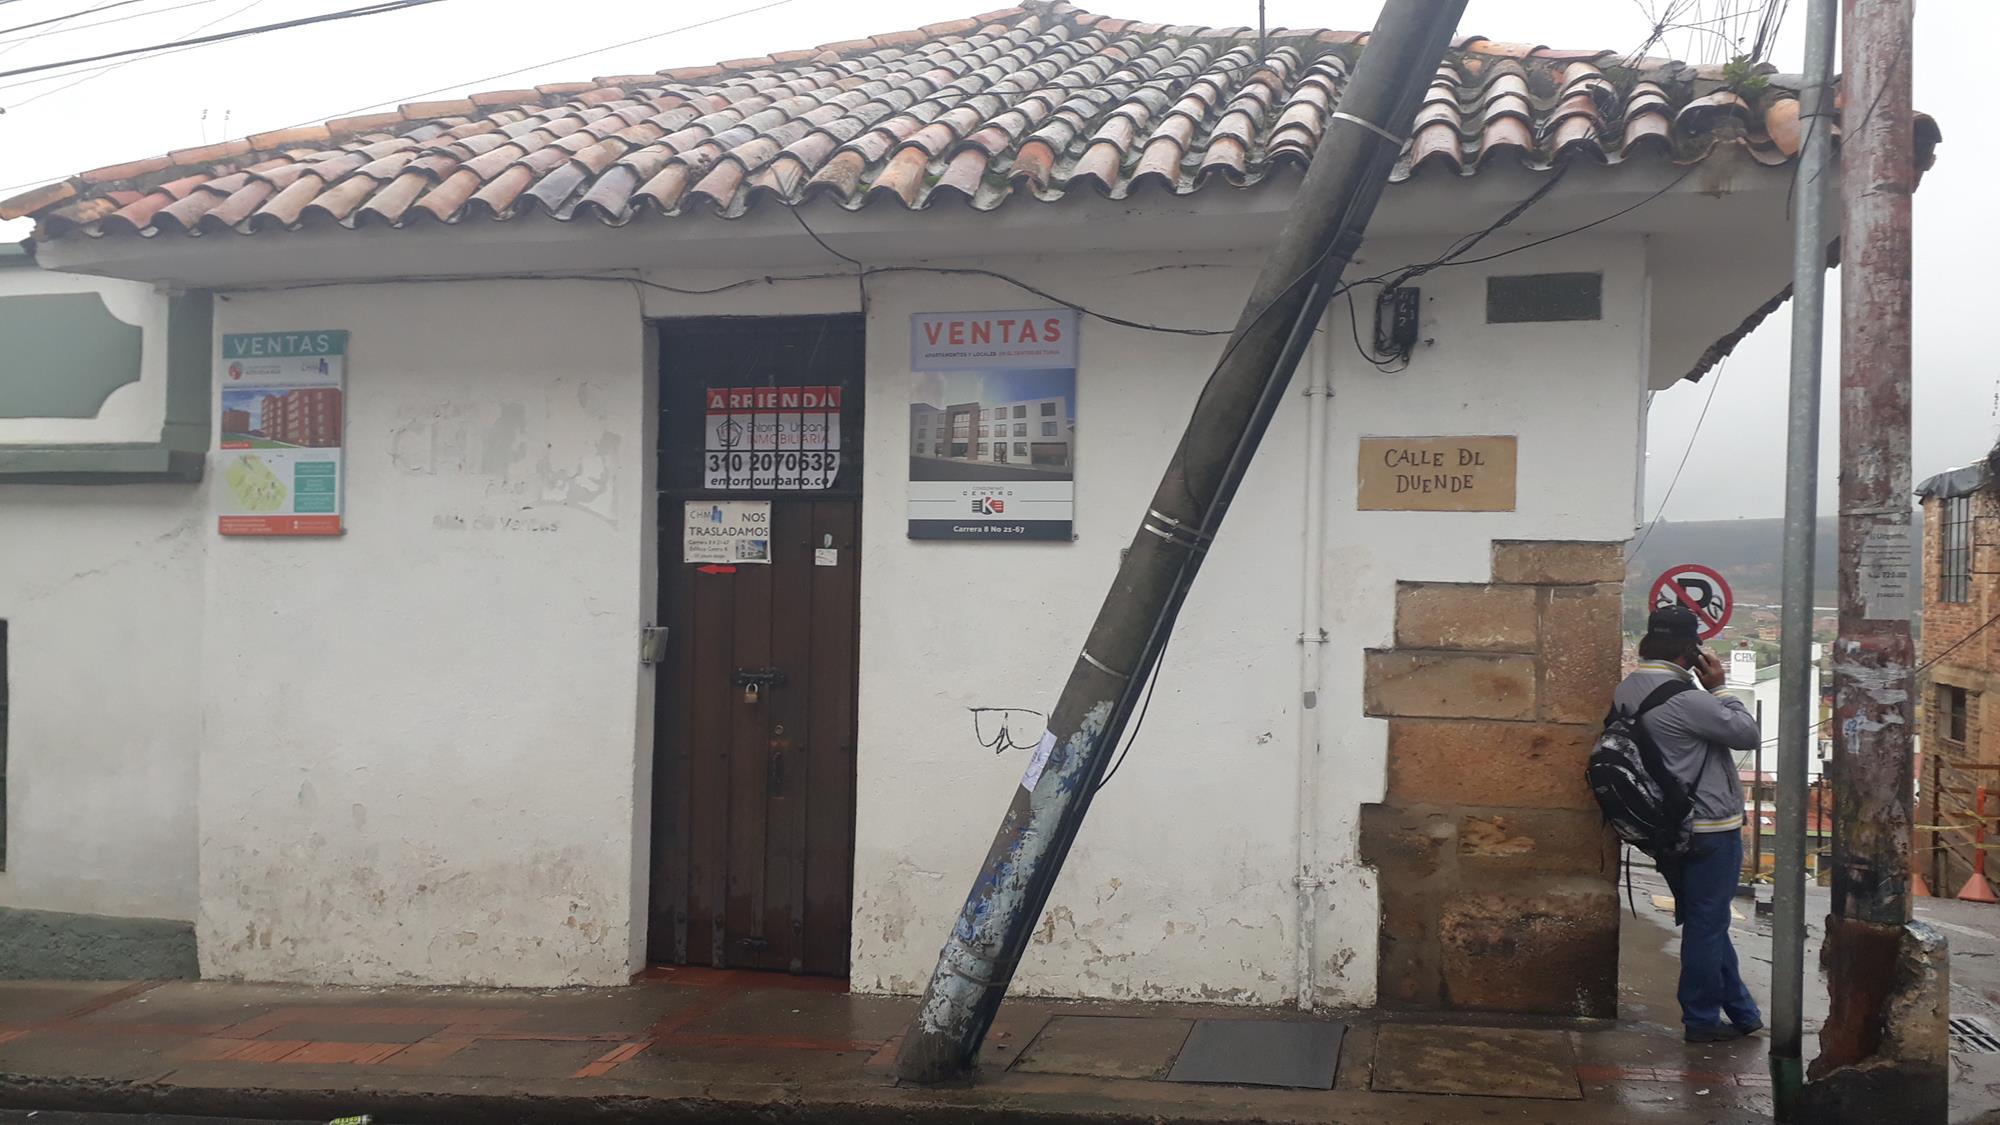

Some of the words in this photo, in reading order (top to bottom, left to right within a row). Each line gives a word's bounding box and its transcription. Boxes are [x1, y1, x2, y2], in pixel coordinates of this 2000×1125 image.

[923, 318, 1062, 346] VENTAS
[234, 335, 330, 355] VENTAS
[710, 392, 836, 409] ARRIENDA
[709, 453, 742, 472] 310
[749, 453, 836, 472] 2070632
[1384, 448, 1444, 468] CALLE
[1396, 474, 1474, 493] DUENDE
[742, 512, 766, 523] NOS
[688, 526, 769, 537] TRASLADAMOS
[953, 525, 982, 533] Carrera
[983, 525, 989, 533] 8
[990, 525, 1002, 533] No
[1003, 525, 1025, 534] 21-67
